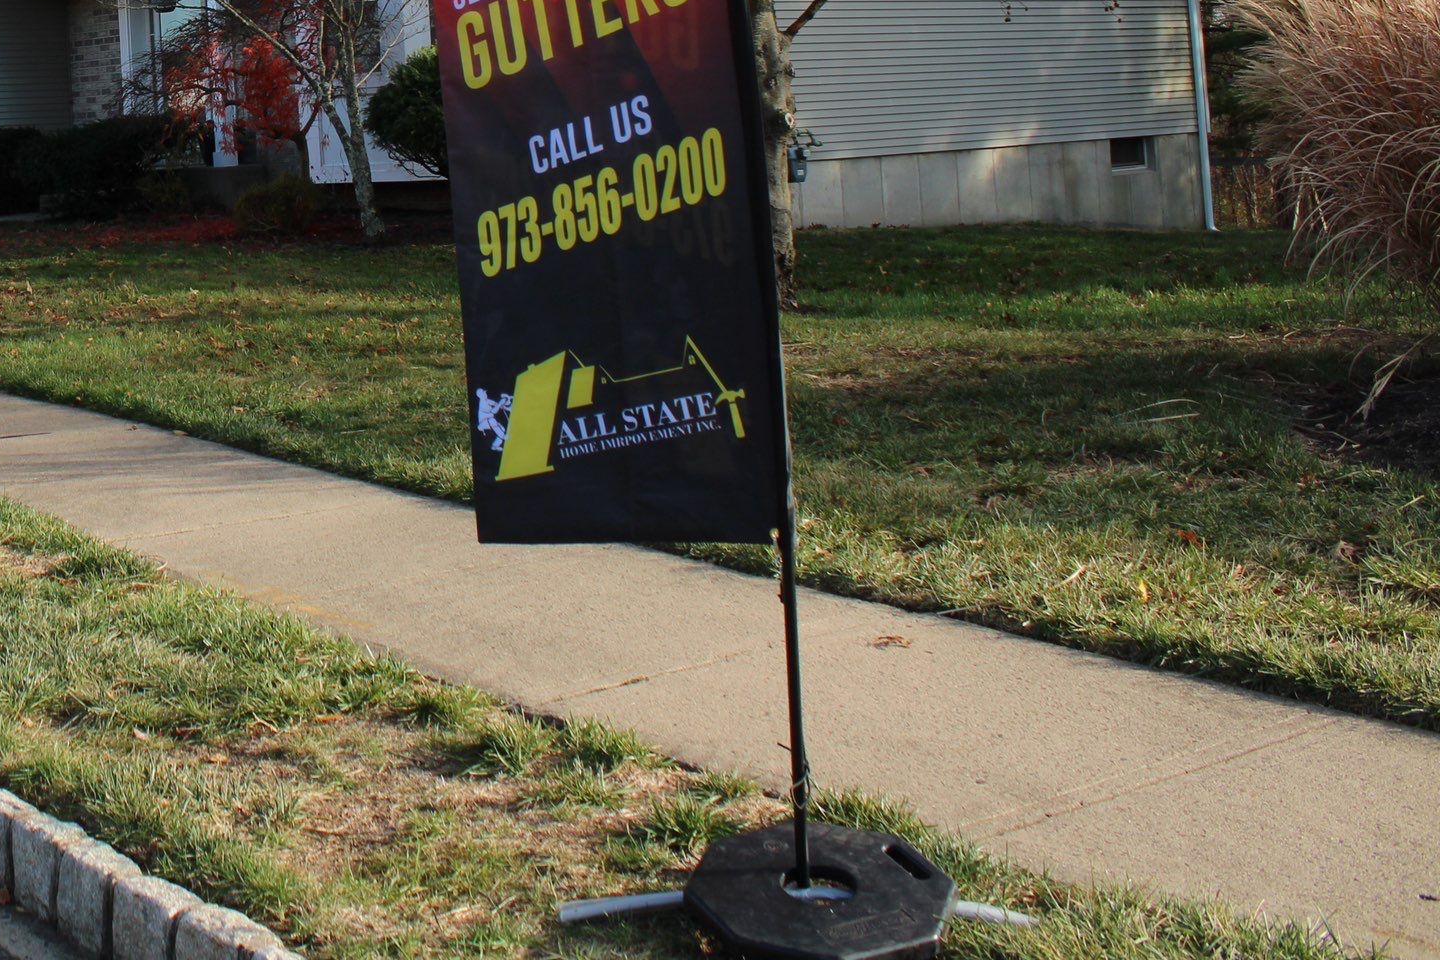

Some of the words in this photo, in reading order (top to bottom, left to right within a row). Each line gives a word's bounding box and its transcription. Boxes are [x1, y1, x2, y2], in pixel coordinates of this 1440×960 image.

[528, 116, 604, 174] CALL
[610, 95, 652, 144] US
[477, 127, 727, 278] 973-856-0200
[557, 412, 617, 445] ALL
[622, 392, 717, 432] STATE
[560, 443, 599, 459] HOME
[696, 419, 722, 433] INC.
